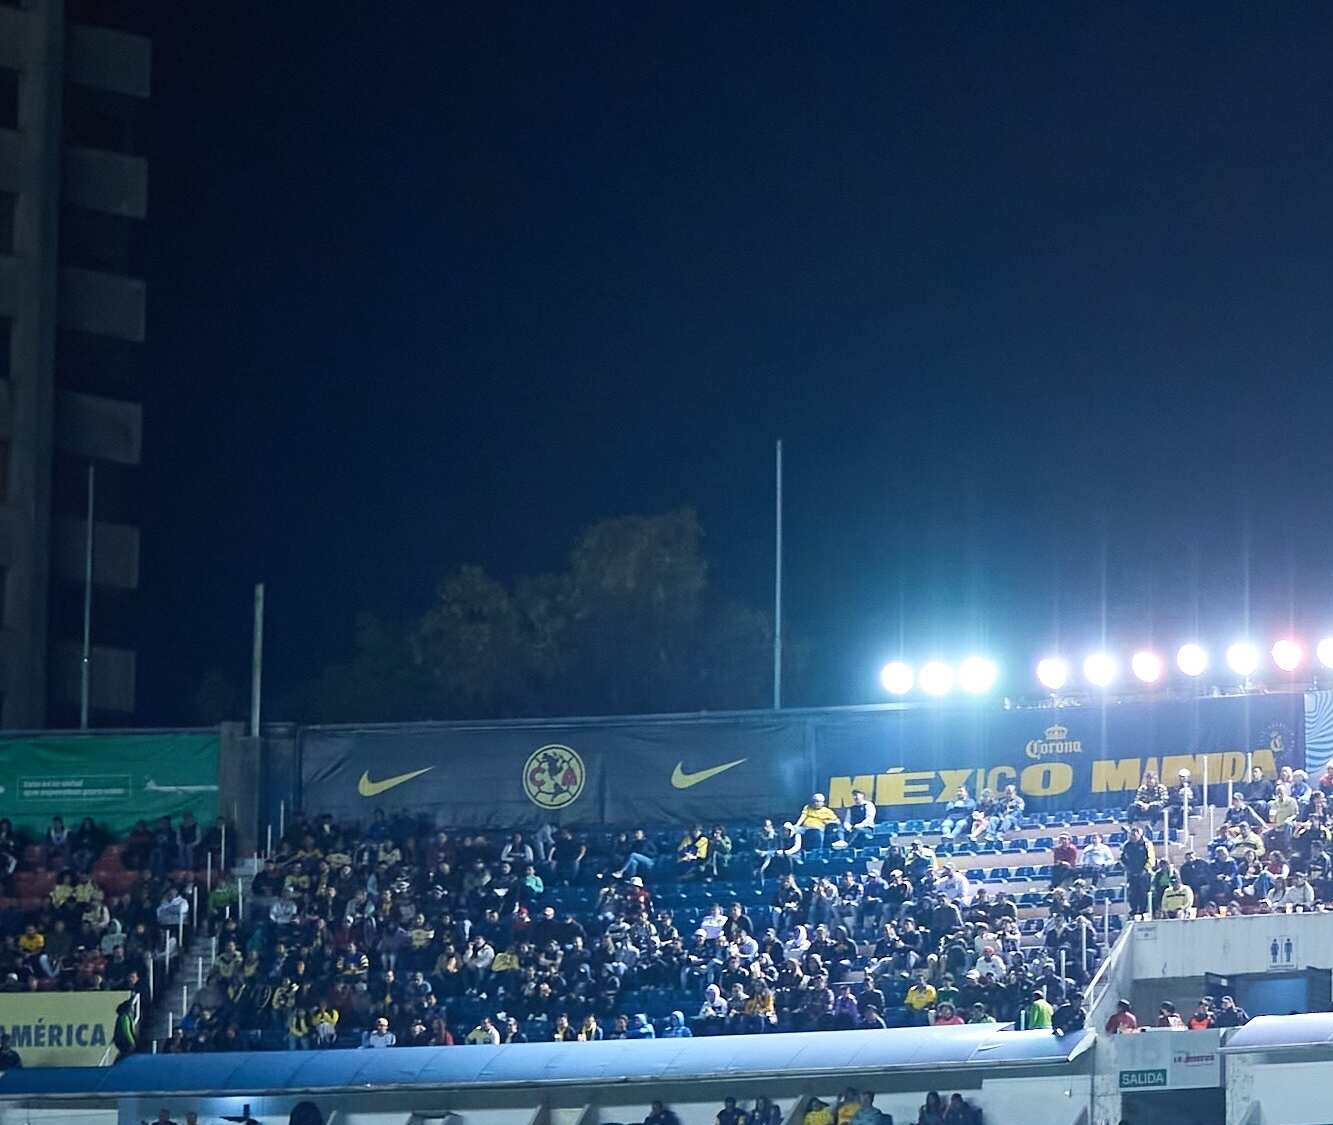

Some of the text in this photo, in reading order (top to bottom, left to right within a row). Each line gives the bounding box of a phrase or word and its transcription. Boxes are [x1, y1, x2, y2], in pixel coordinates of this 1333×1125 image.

[1026, 740, 1081, 759] Corona
[829, 766, 1073, 808] MÉXICO
[1121, 1072, 1164, 1085] SALIDA
